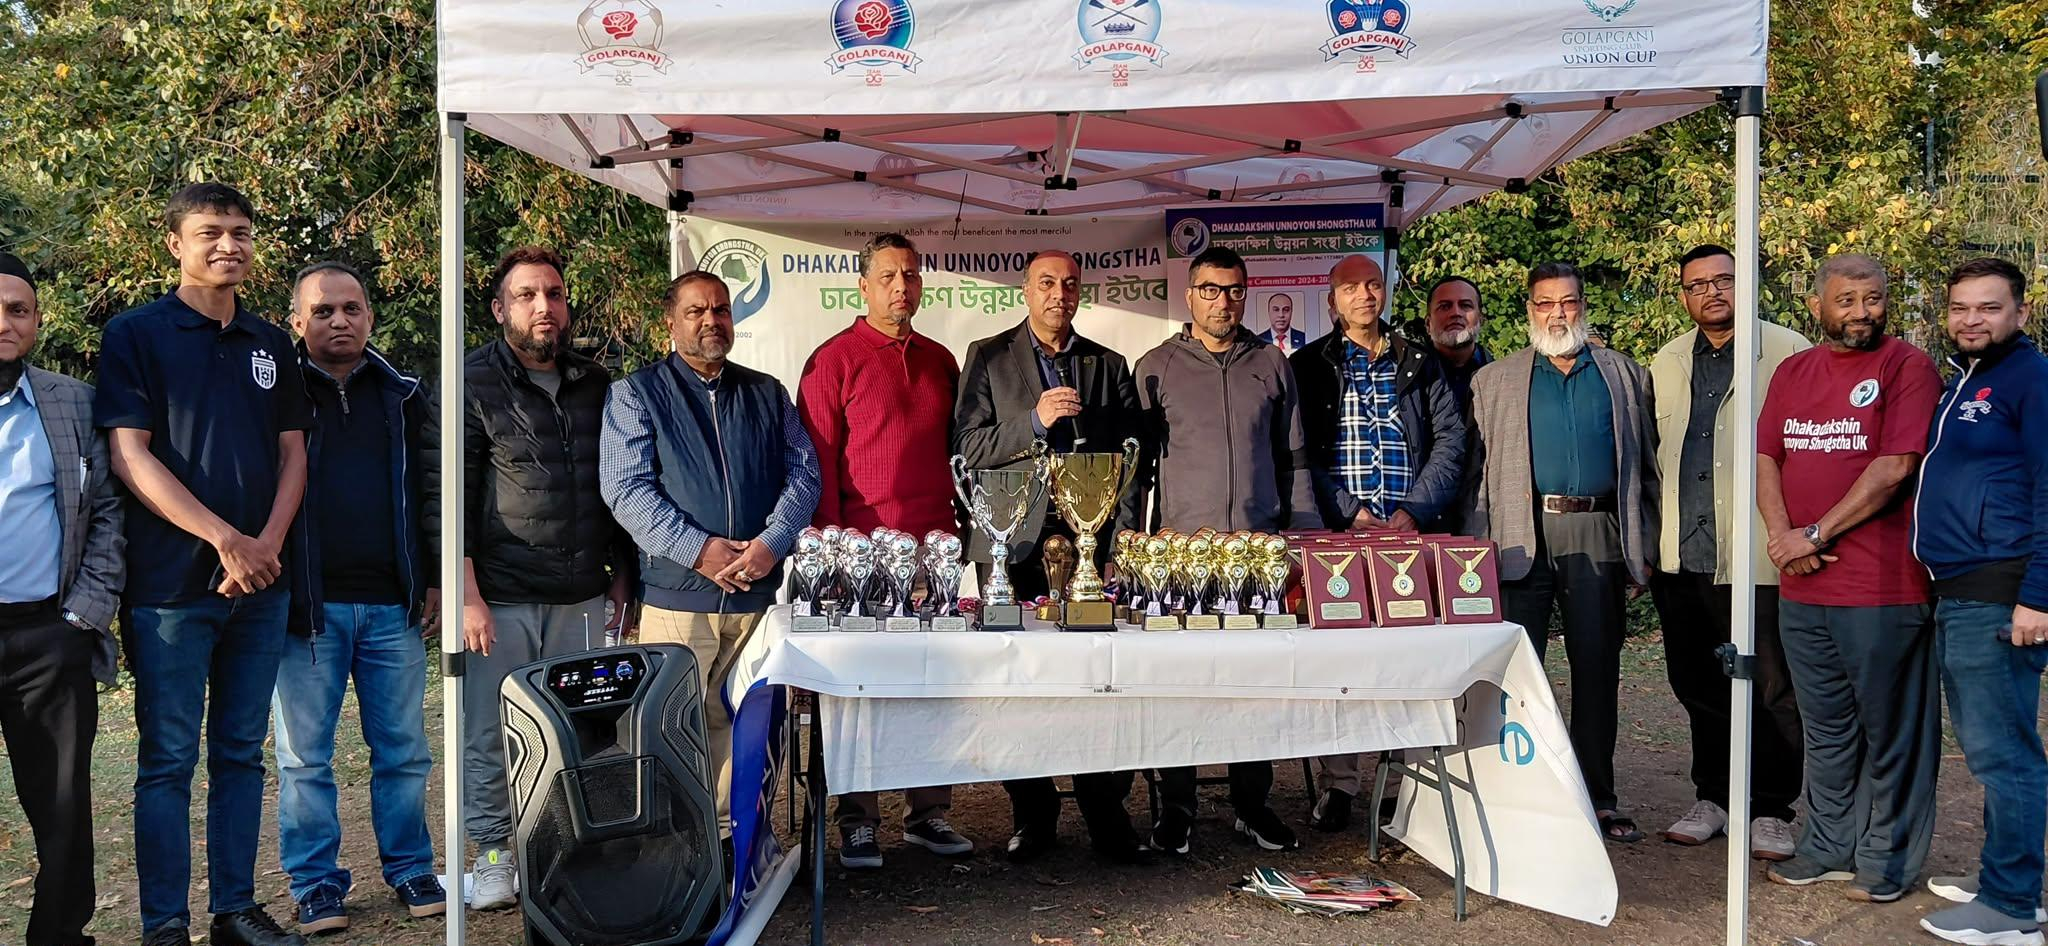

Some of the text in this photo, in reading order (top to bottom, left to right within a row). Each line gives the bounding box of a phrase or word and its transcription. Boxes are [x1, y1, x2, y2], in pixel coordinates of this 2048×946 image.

[1332, 34, 1405, 49] GOLAPGANJ
[1561, 30, 1655, 45] GOLAPGANJ
[587, 49, 661, 65] GOLAPGANJ
[837, 49, 910, 64] GOLAPGANJ
[1084, 42, 1157, 58] GOLAPGANJ
[1562, 50, 1657, 64] UNION CUP
[844, 229, 852, 237] In
[854, 228, 867, 237] the
[904, 228, 925, 237] Allah
[928, 228, 939, 236] the
[962, 226, 1003, 236] beneficent
[1005, 227, 1017, 235] the
[1040, 226, 1072, 235] merciful
[1211, 218, 1377, 233] DHAKADAKSHIN UNNOYON SHONGSTHA UK
[783, 253, 938, 273] DHAKADIN
[1254, 277, 1296, 285] Committee
[1852, 435, 1868, 451] UK
